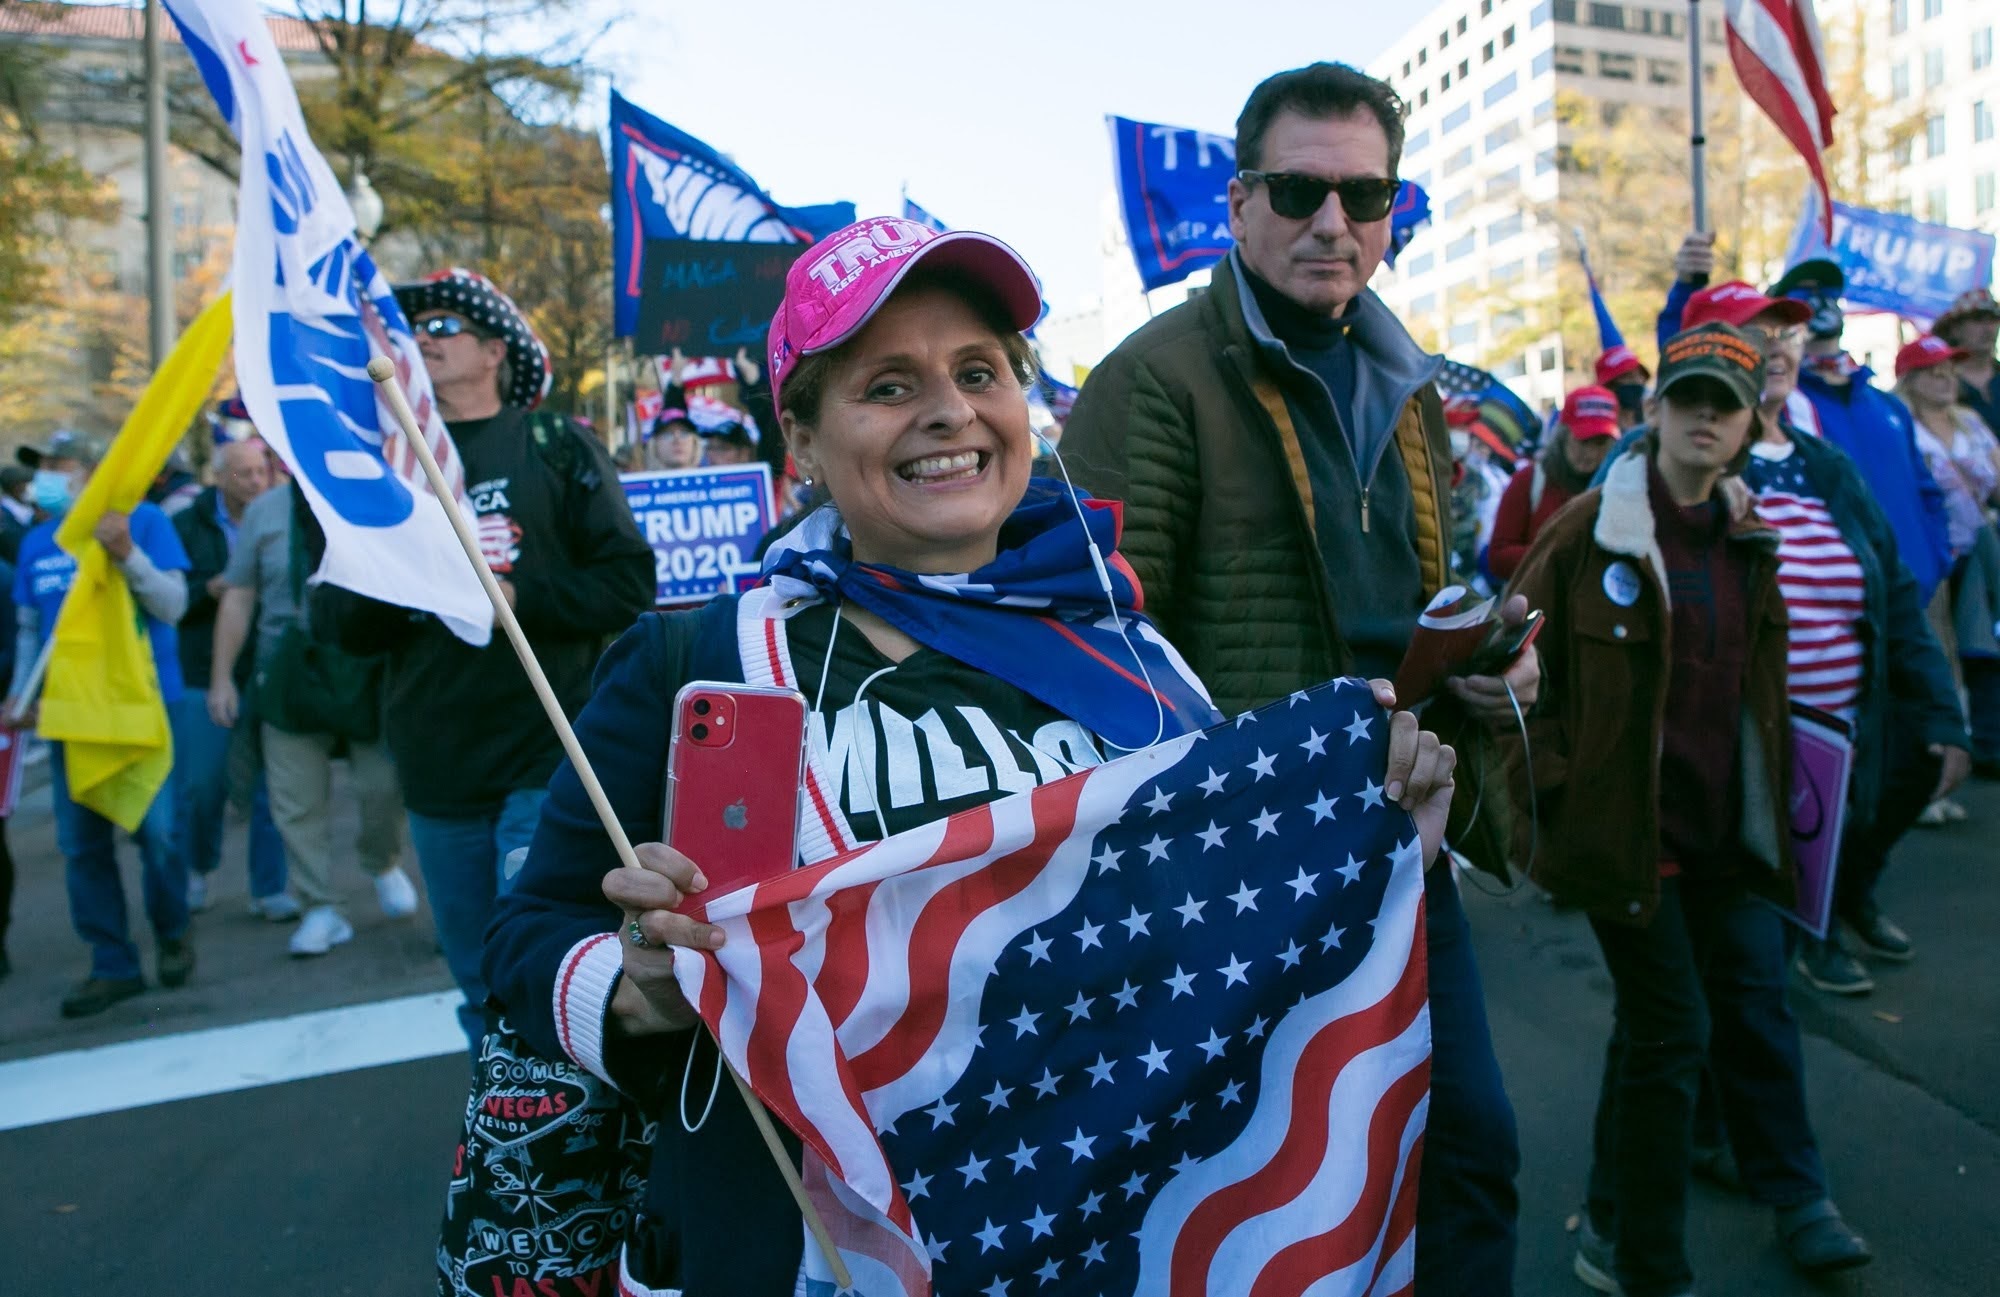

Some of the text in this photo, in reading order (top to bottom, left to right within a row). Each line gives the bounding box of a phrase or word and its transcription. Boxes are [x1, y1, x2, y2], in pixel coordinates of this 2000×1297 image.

[809, 223, 938, 290] TRU
[830, 265, 865, 296] KEEP
[627, 494, 652, 508] EEP
[654, 542, 741, 583] 2020
[484, 1092, 568, 1119] VEGAS
[478, 1114, 528, 1133] NEVADA
[507, 1260, 529, 1276] TO
